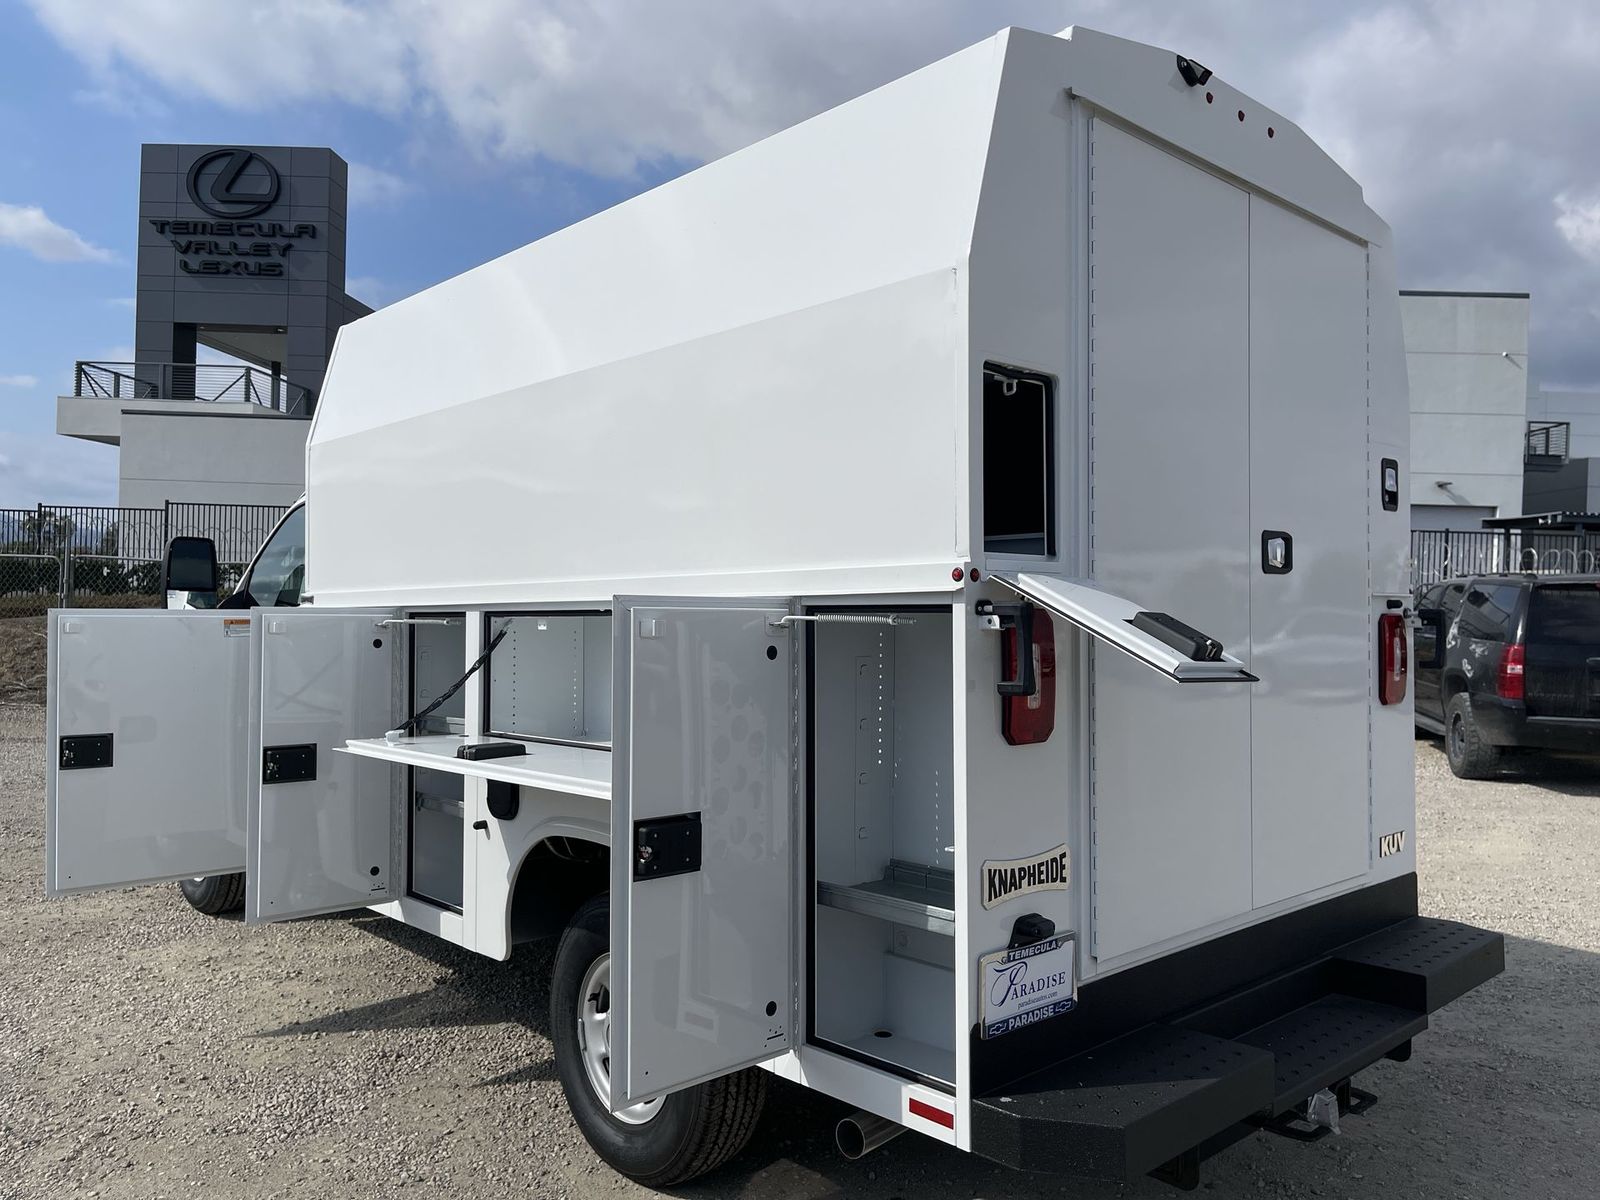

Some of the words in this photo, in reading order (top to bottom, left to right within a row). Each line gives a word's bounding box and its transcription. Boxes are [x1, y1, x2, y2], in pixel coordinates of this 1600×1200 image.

[149, 220, 317, 239] TEMECULA
[171, 240, 294, 257] VALLEY
[179, 259, 284, 277] LEXUS
[1379, 830, 1405, 858] KUV
[987, 851, 1067, 903] KNAPHEIDE
[1009, 940, 1057, 961] TEMECULA
[1009, 1004, 1054, 1031] PARADISE
